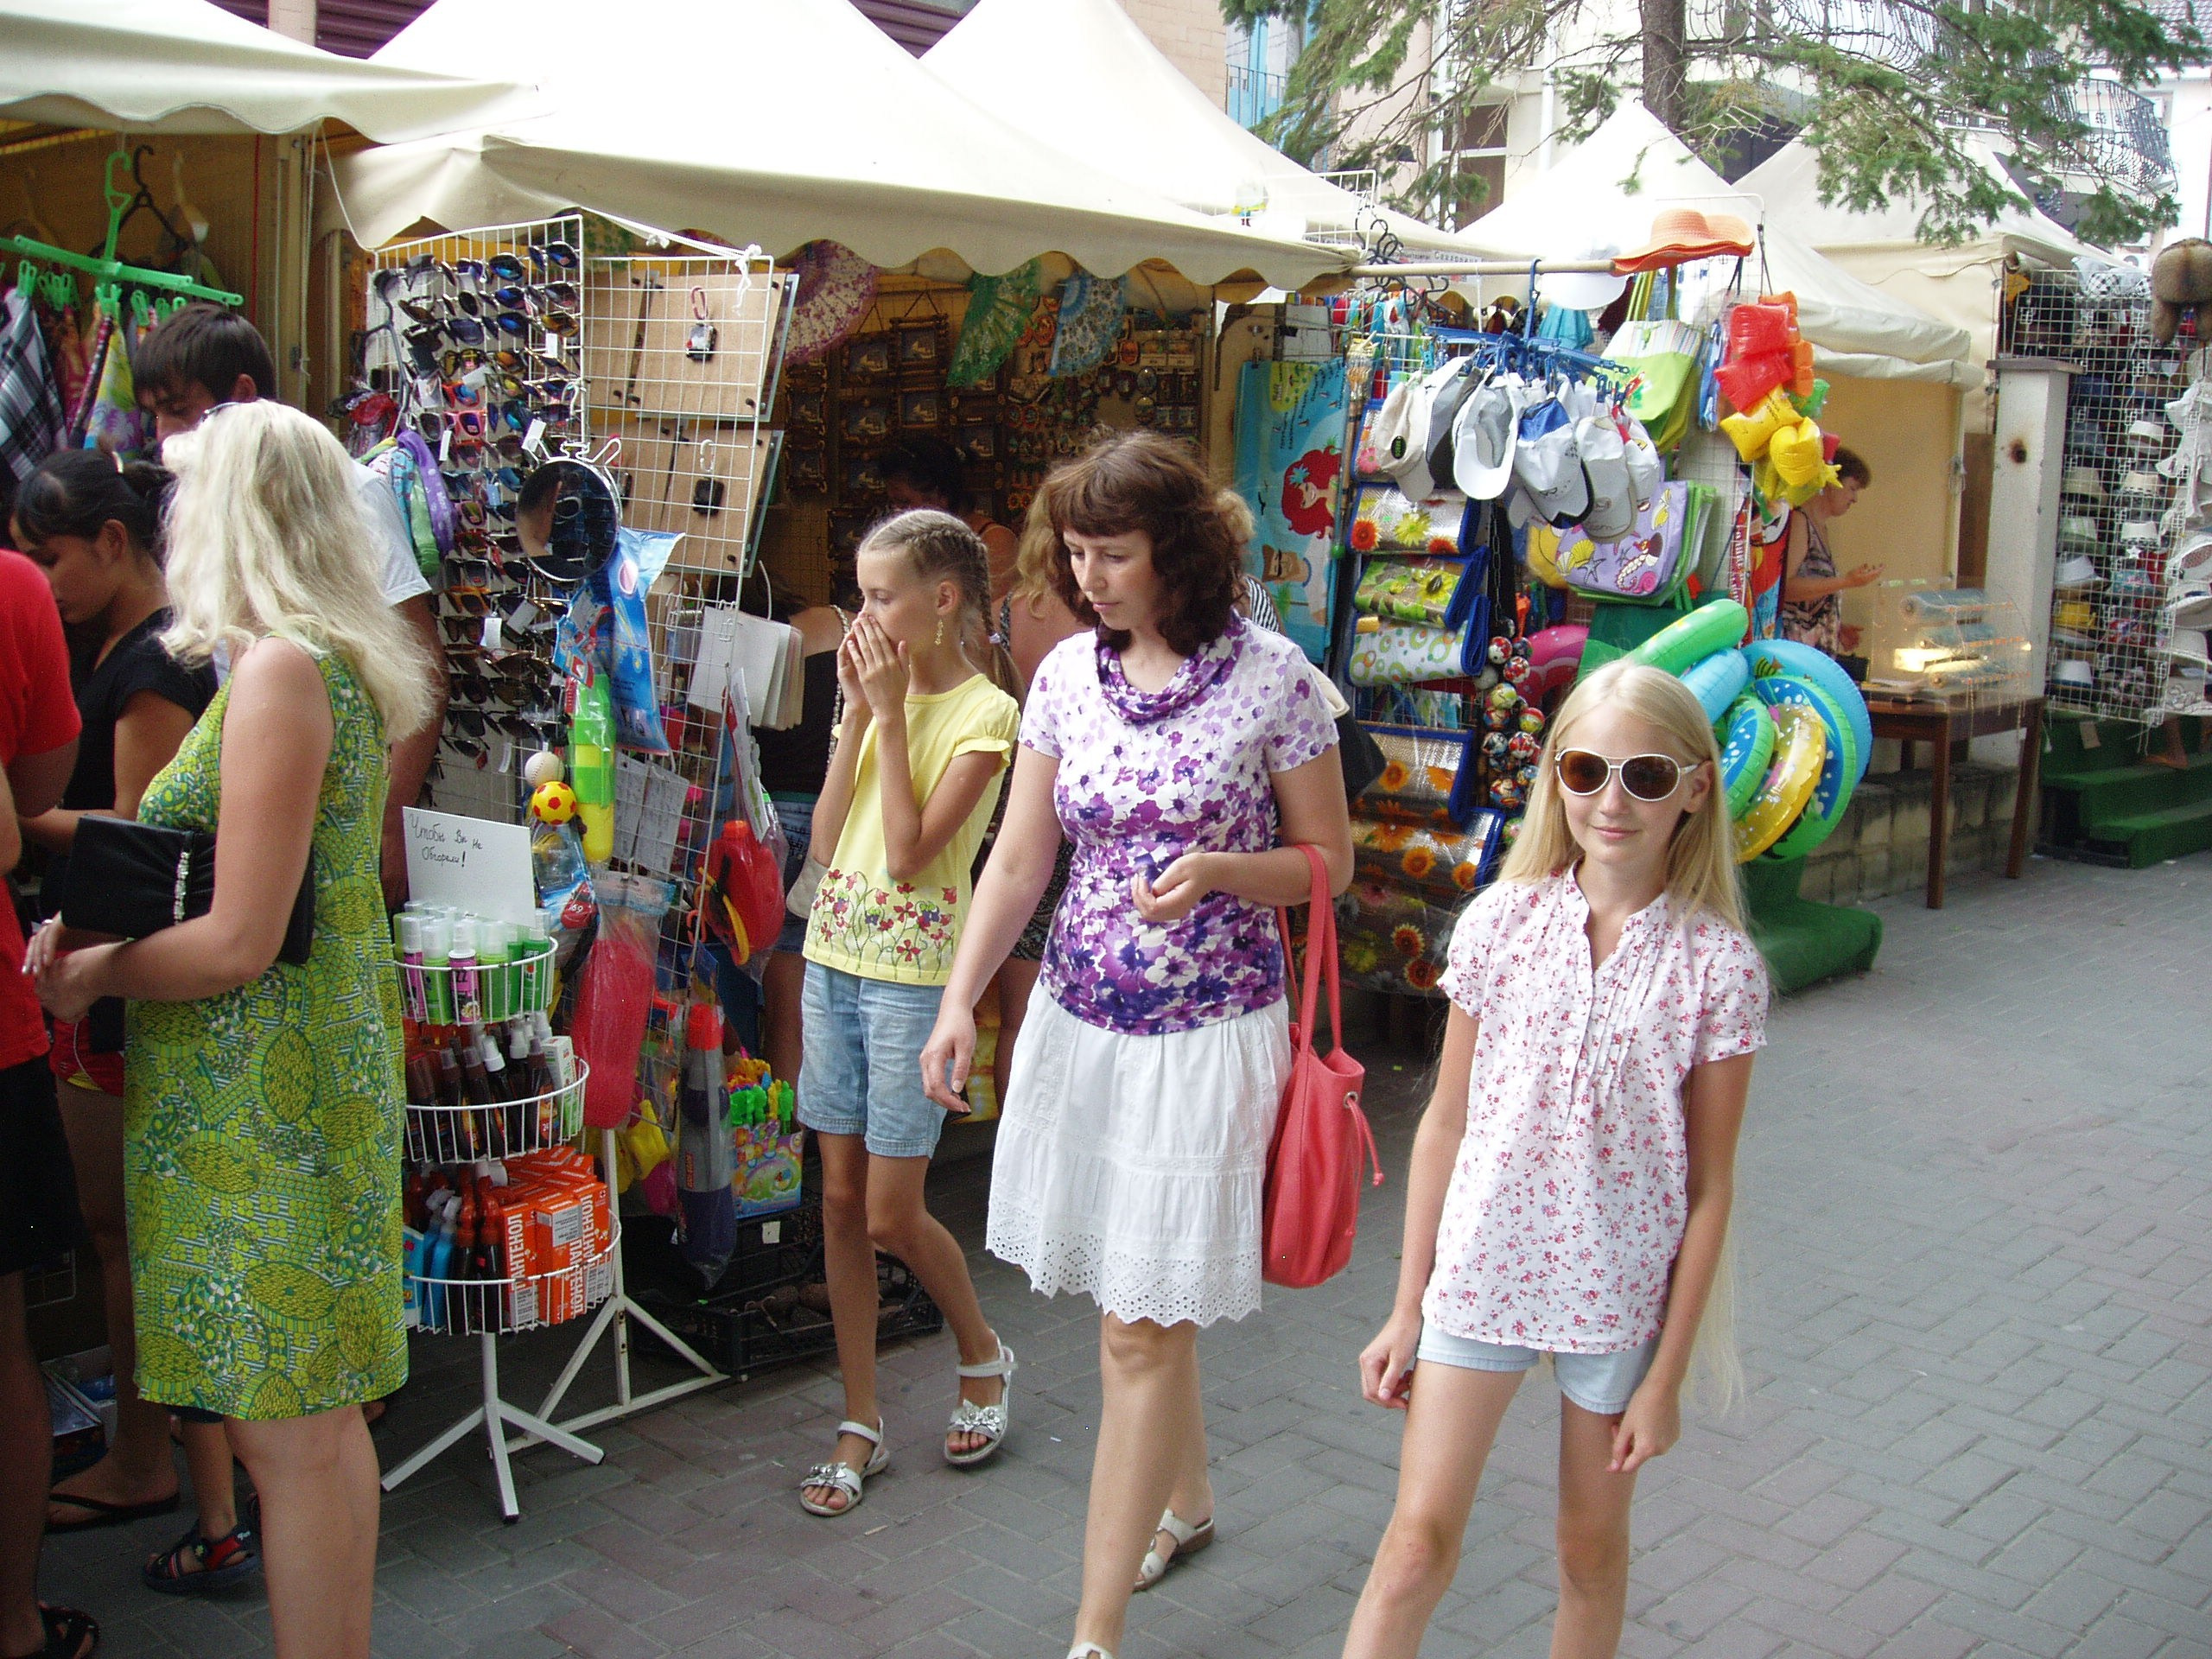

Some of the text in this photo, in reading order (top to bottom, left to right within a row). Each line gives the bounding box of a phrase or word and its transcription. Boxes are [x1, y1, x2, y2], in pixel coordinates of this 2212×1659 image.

[409, 814, 446, 843] Чтобы
[422, 847, 466, 868] Обгорели!
[507, 1213, 527, 1291] ПАНТЕНОЛ
